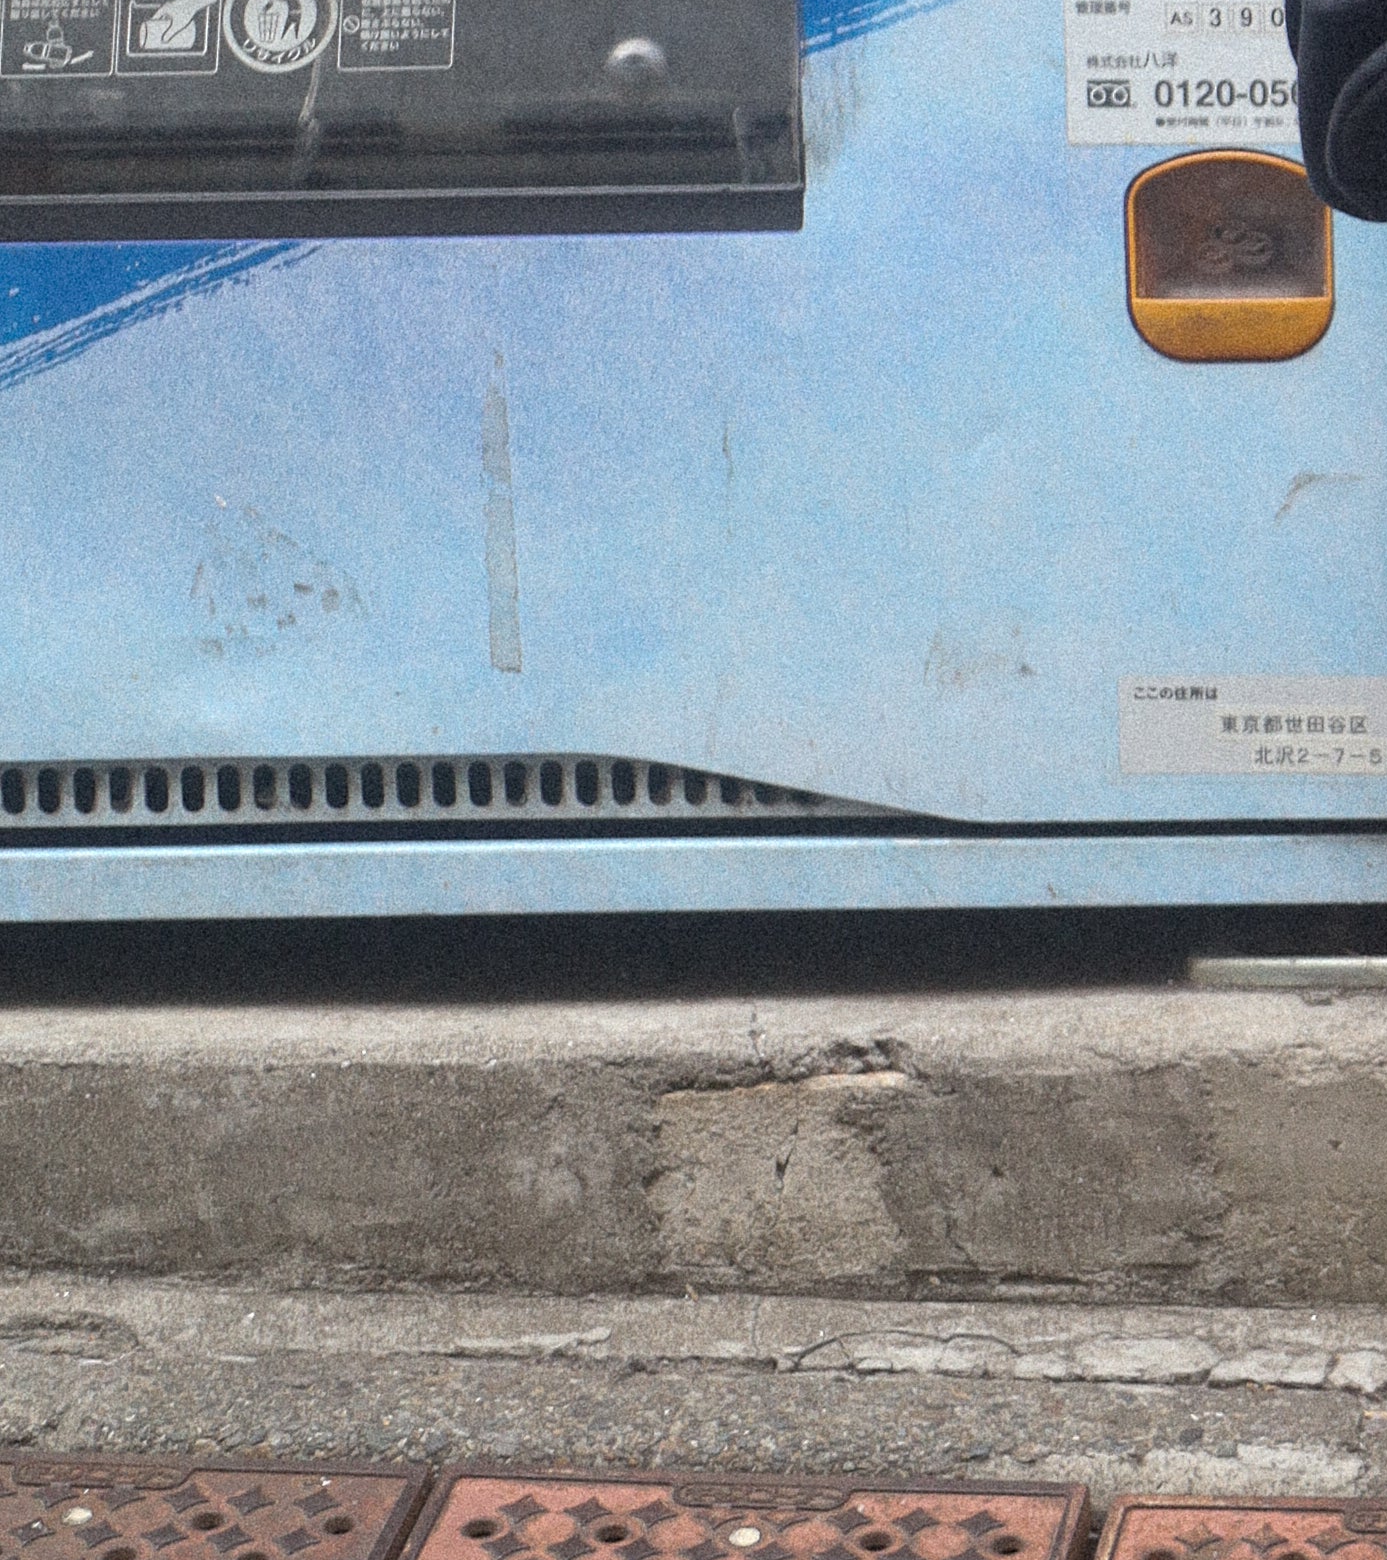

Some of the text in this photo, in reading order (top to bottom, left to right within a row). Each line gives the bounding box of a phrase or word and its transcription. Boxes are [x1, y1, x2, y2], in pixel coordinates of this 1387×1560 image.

[1208, 7, 1223, 28] 3
[1240, 7, 1254, 28] 9
[1220, 714, 1369, 735] 東京都世田谷区
